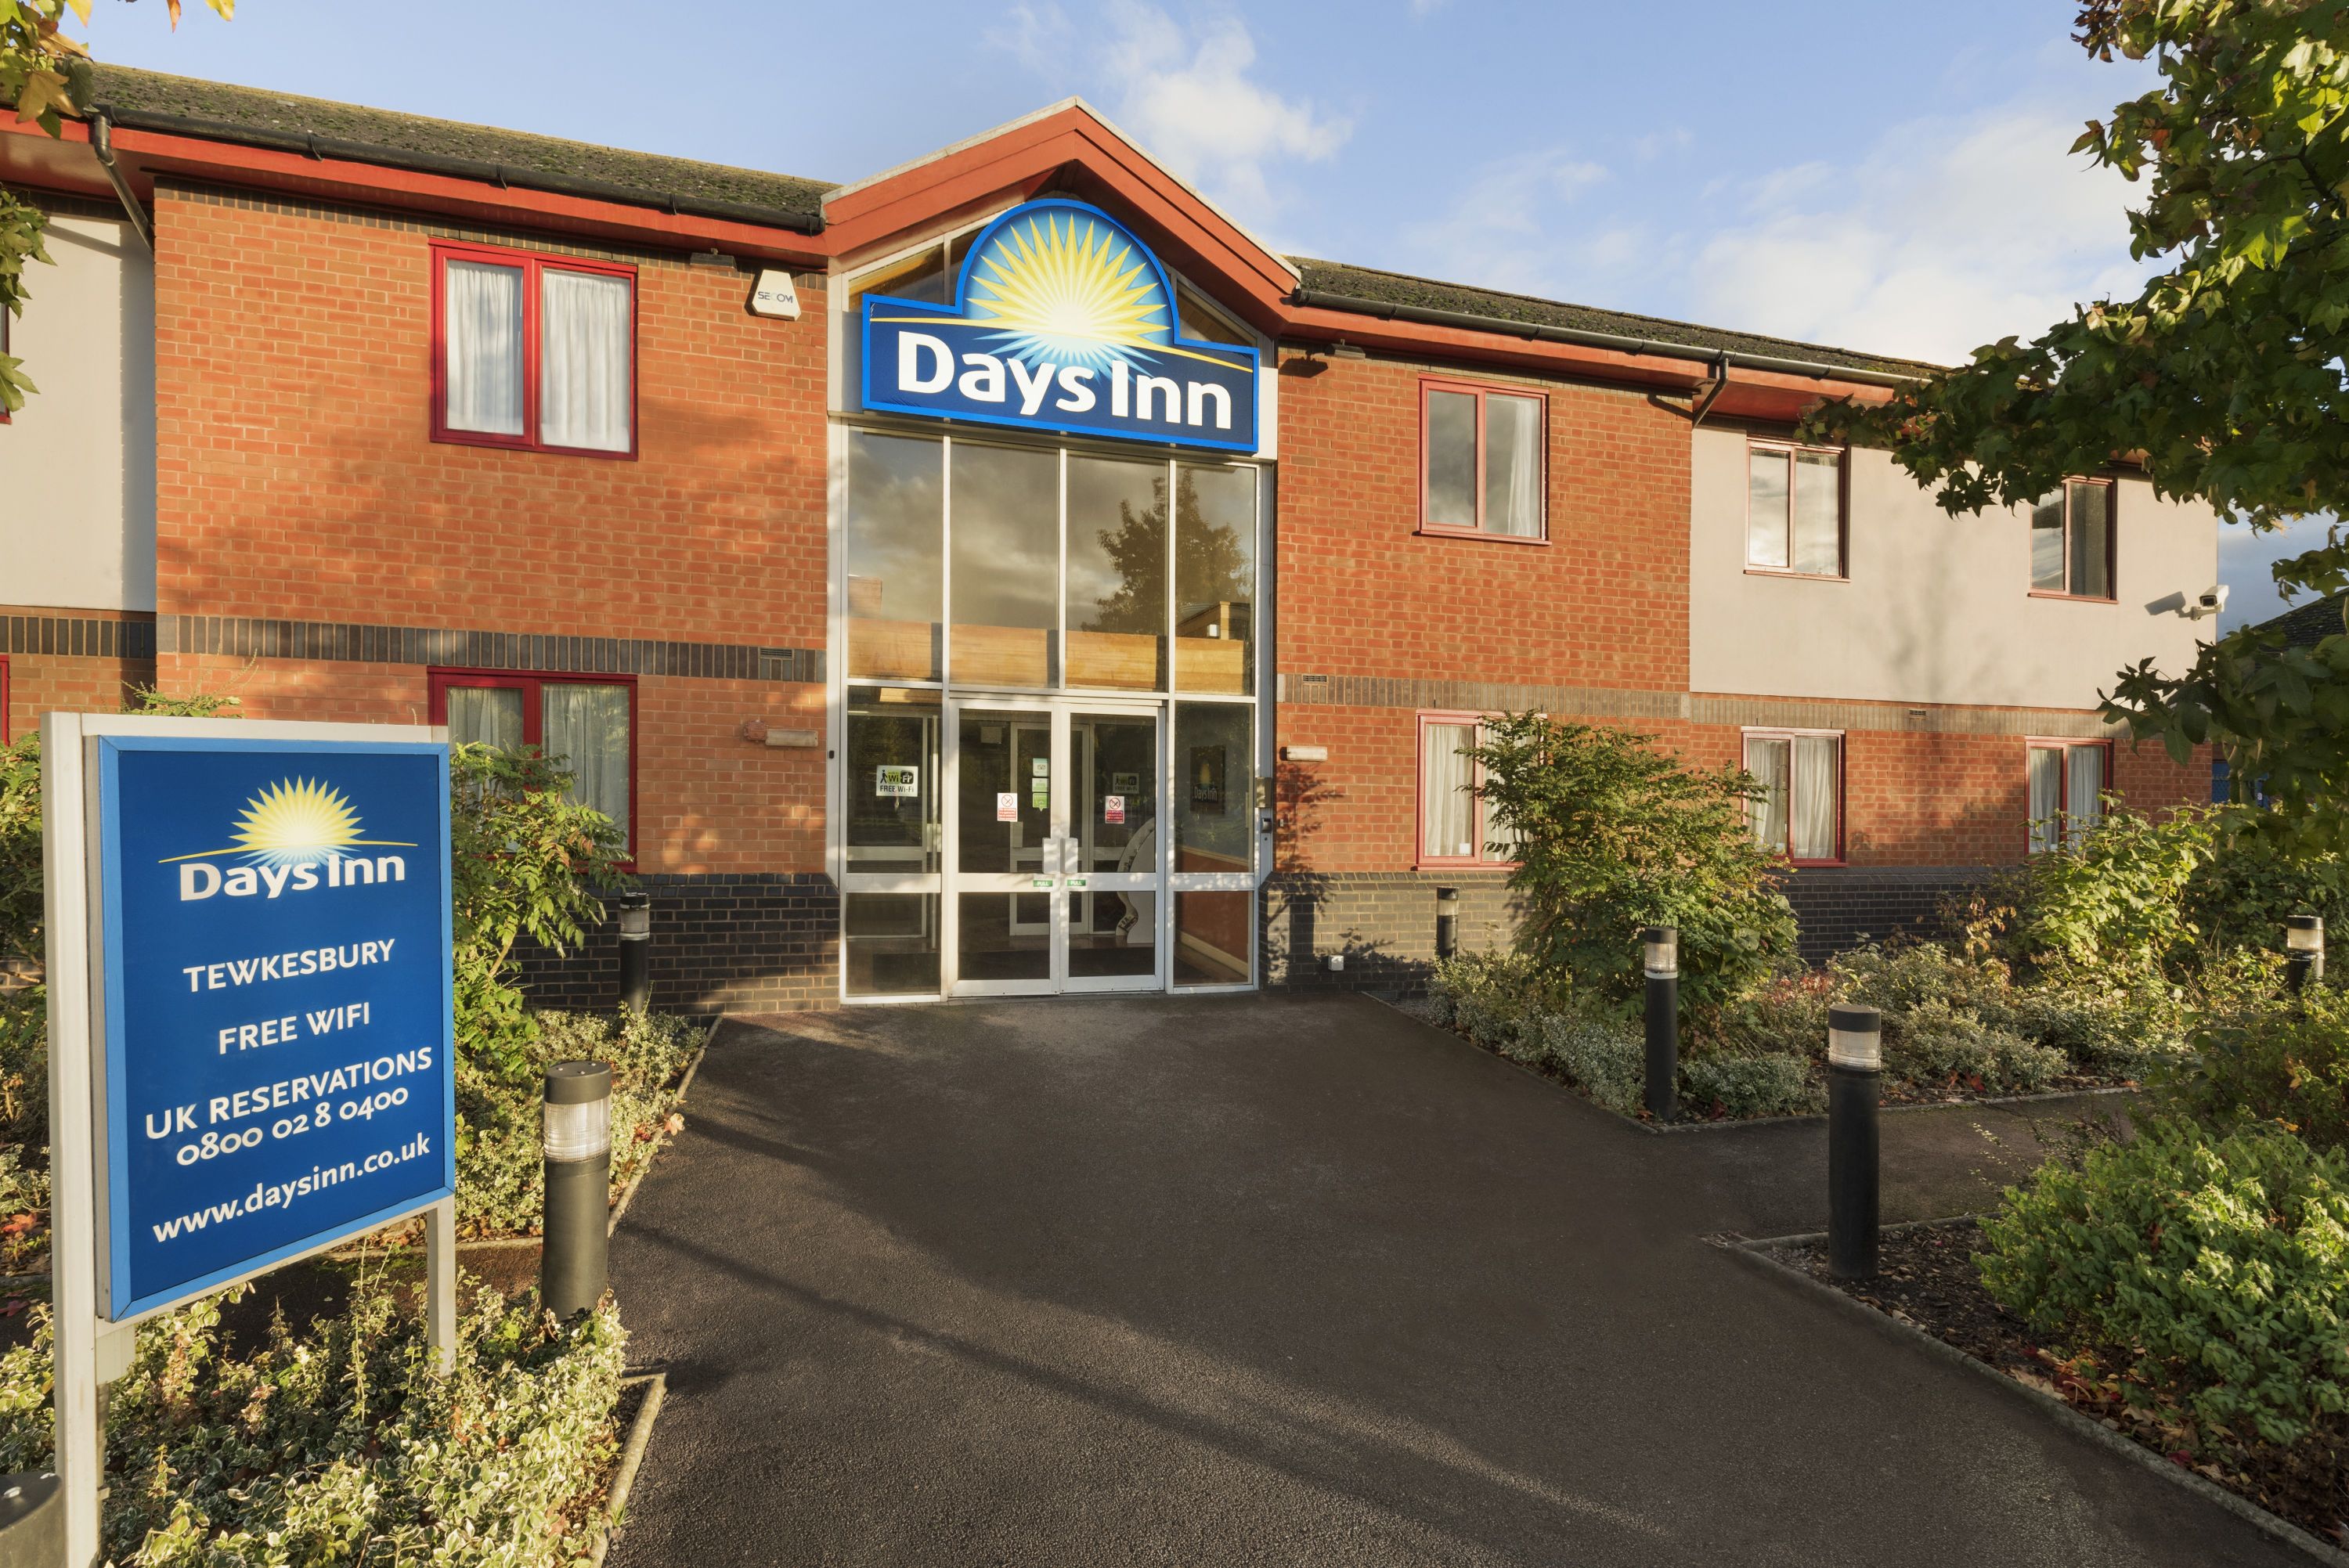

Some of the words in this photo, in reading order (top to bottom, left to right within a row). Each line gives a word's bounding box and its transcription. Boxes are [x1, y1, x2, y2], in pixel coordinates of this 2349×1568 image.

[897, 330, 1096, 416] Days
[1111, 359, 1232, 430] Inn
[1193, 786, 1207, 801] Days
[1207, 787, 1218, 802] Inn
[179, 862, 318, 901] Days
[327, 853, 406, 889] Inn
[182, 939, 395, 993] TEWKESBURY
[218, 1016, 298, 1055] FREE
[306, 1002, 370, 1036] WIFI
[146, 1105, 198, 1140] UK
[209, 1047, 432, 1124] RESERVATIONS
[176, 1127, 263, 1166] 0800
[340, 1087, 409, 1120] 0400
[152, 1132, 430, 1242] www.daysinn.co.uk
